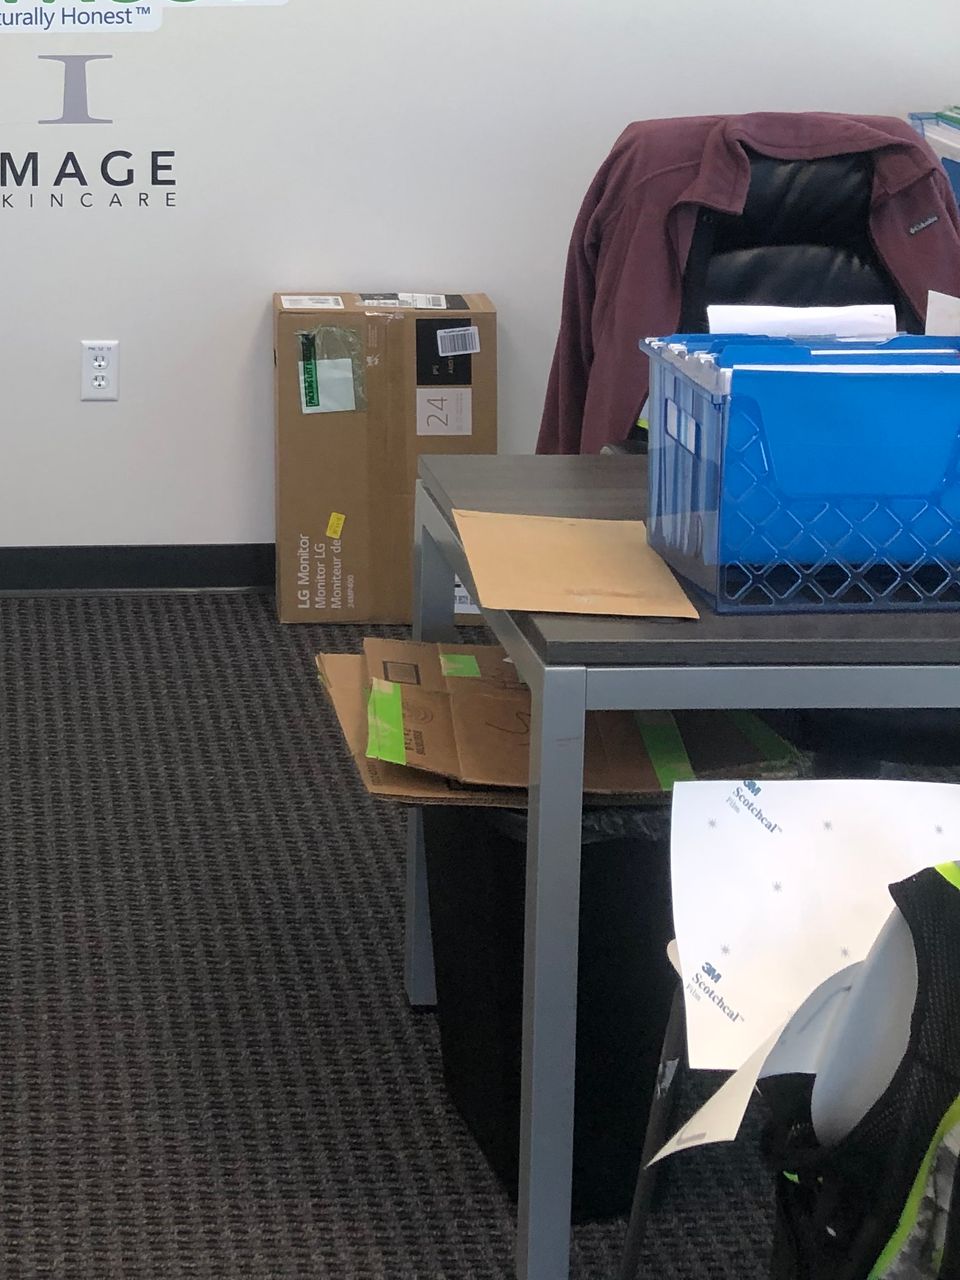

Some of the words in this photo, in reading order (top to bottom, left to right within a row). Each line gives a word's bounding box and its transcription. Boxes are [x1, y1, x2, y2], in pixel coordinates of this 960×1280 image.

[426, 396, 449, 427] 24
[297, 533, 310, 585] Monitor
[314, 543, 326, 558] LG
[314, 561, 326, 608] Monitor
[330, 555, 342, 609] Moniteur
[297, 589, 310, 608] LG
[701, 961, 722, 984] 3M
